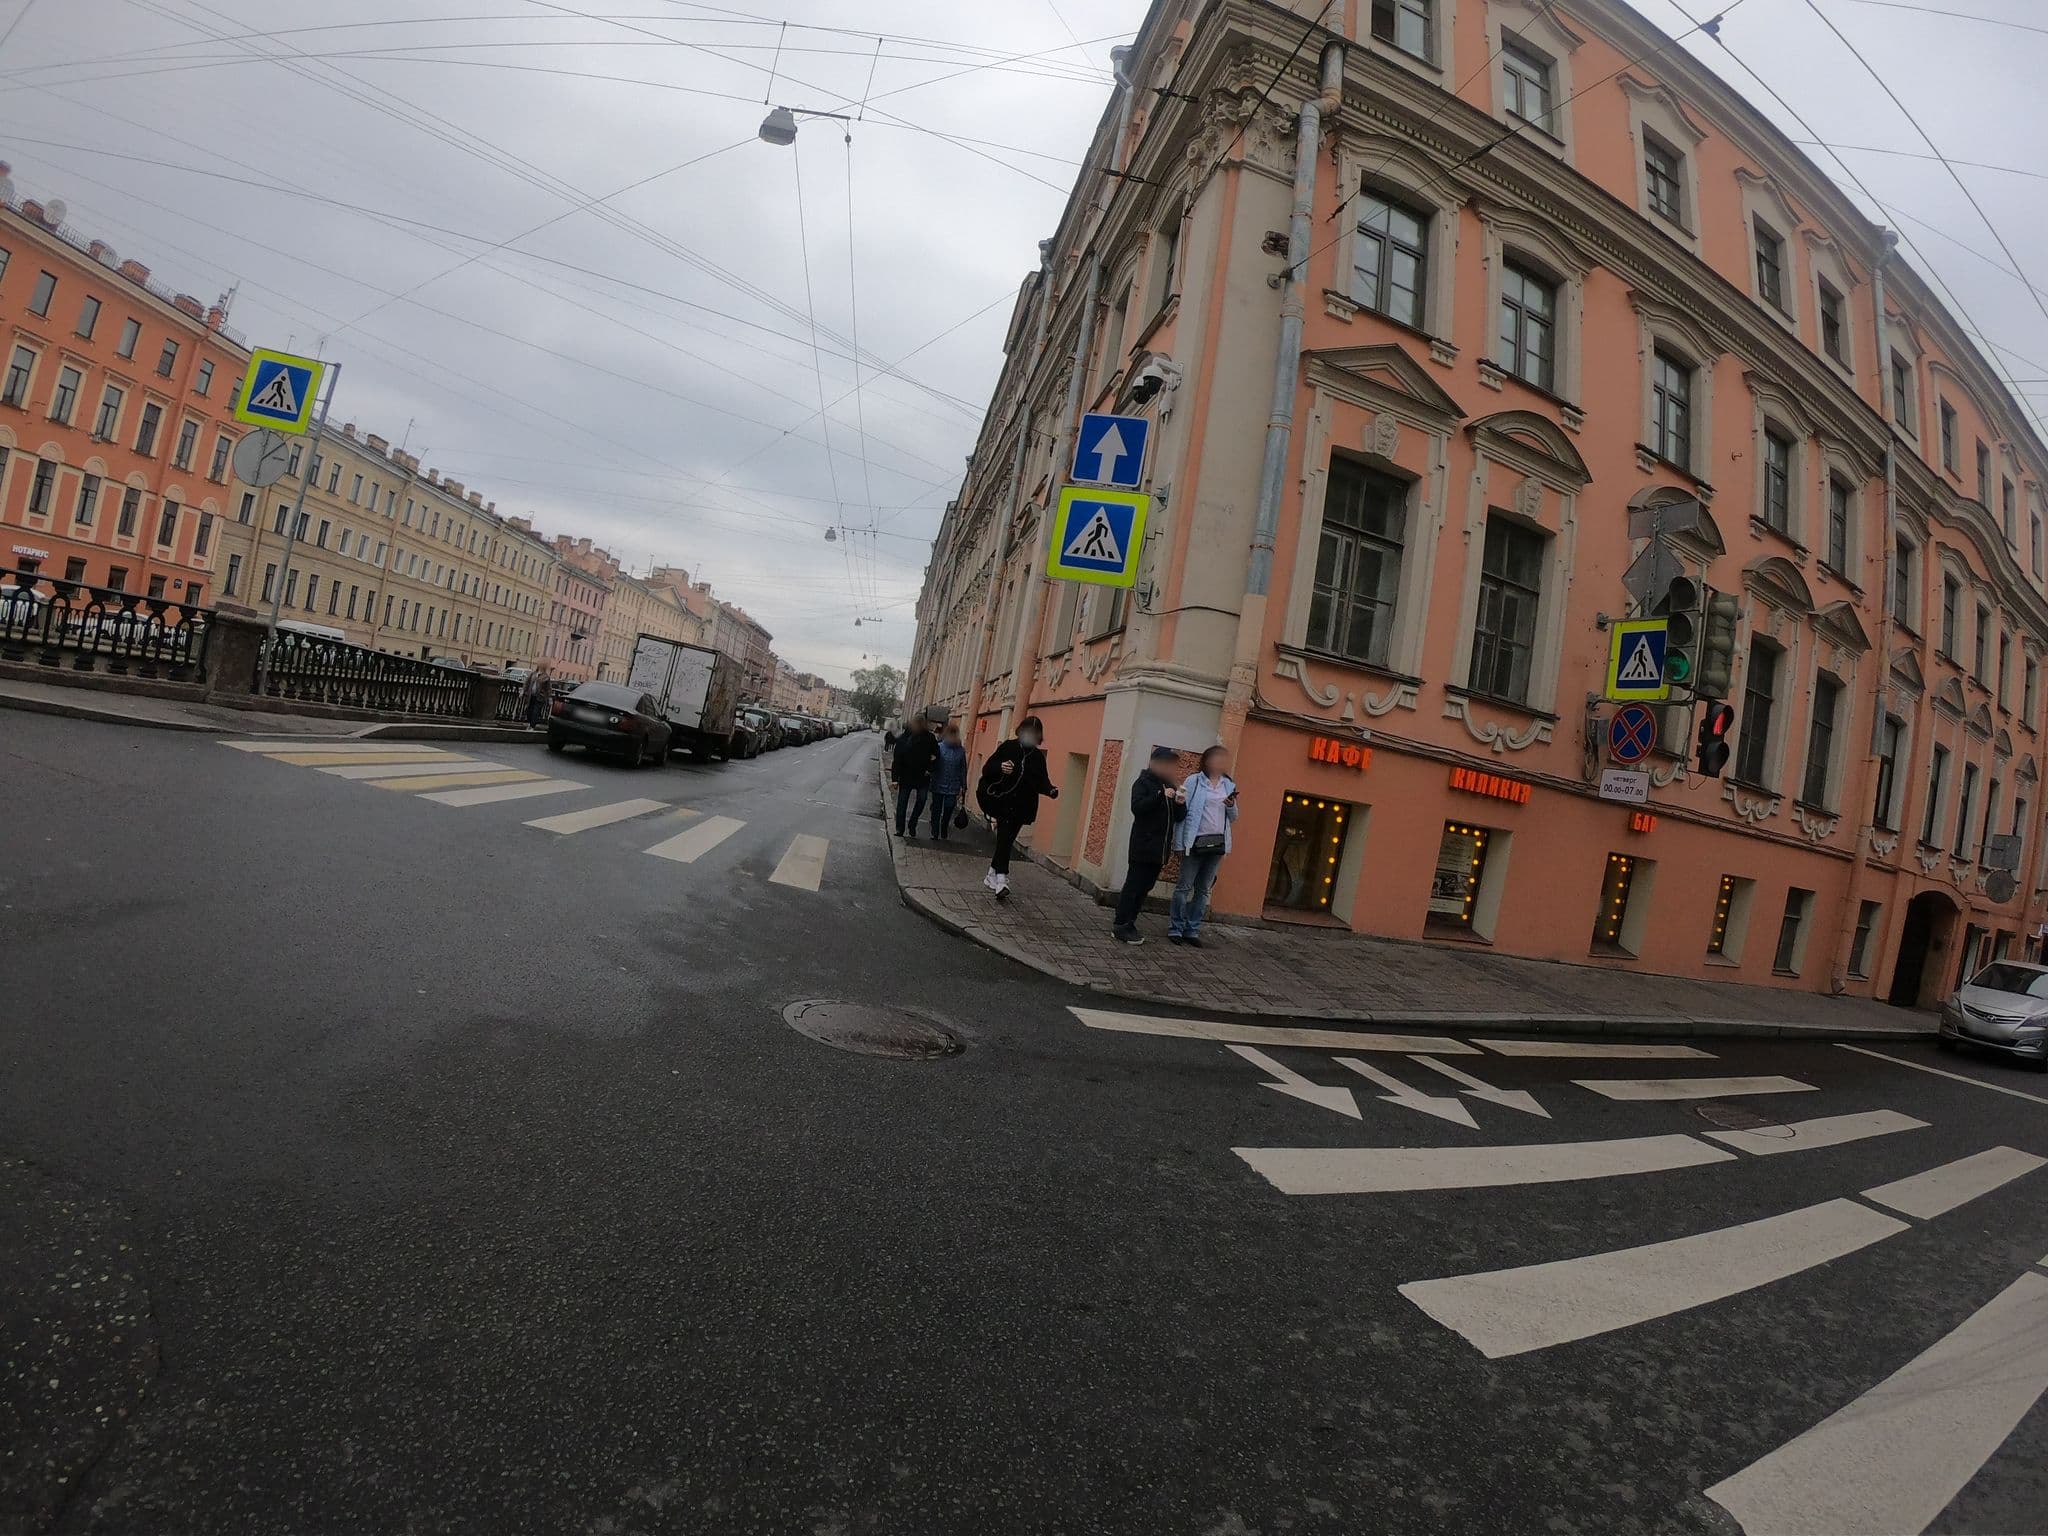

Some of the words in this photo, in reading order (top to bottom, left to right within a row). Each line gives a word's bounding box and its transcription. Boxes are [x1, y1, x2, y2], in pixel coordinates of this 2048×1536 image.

[1312, 736, 1372, 769] КАФЕ
[1452, 767, 1532, 804] КИЛИКИЯ
[1633, 812, 1657, 832] БАР
